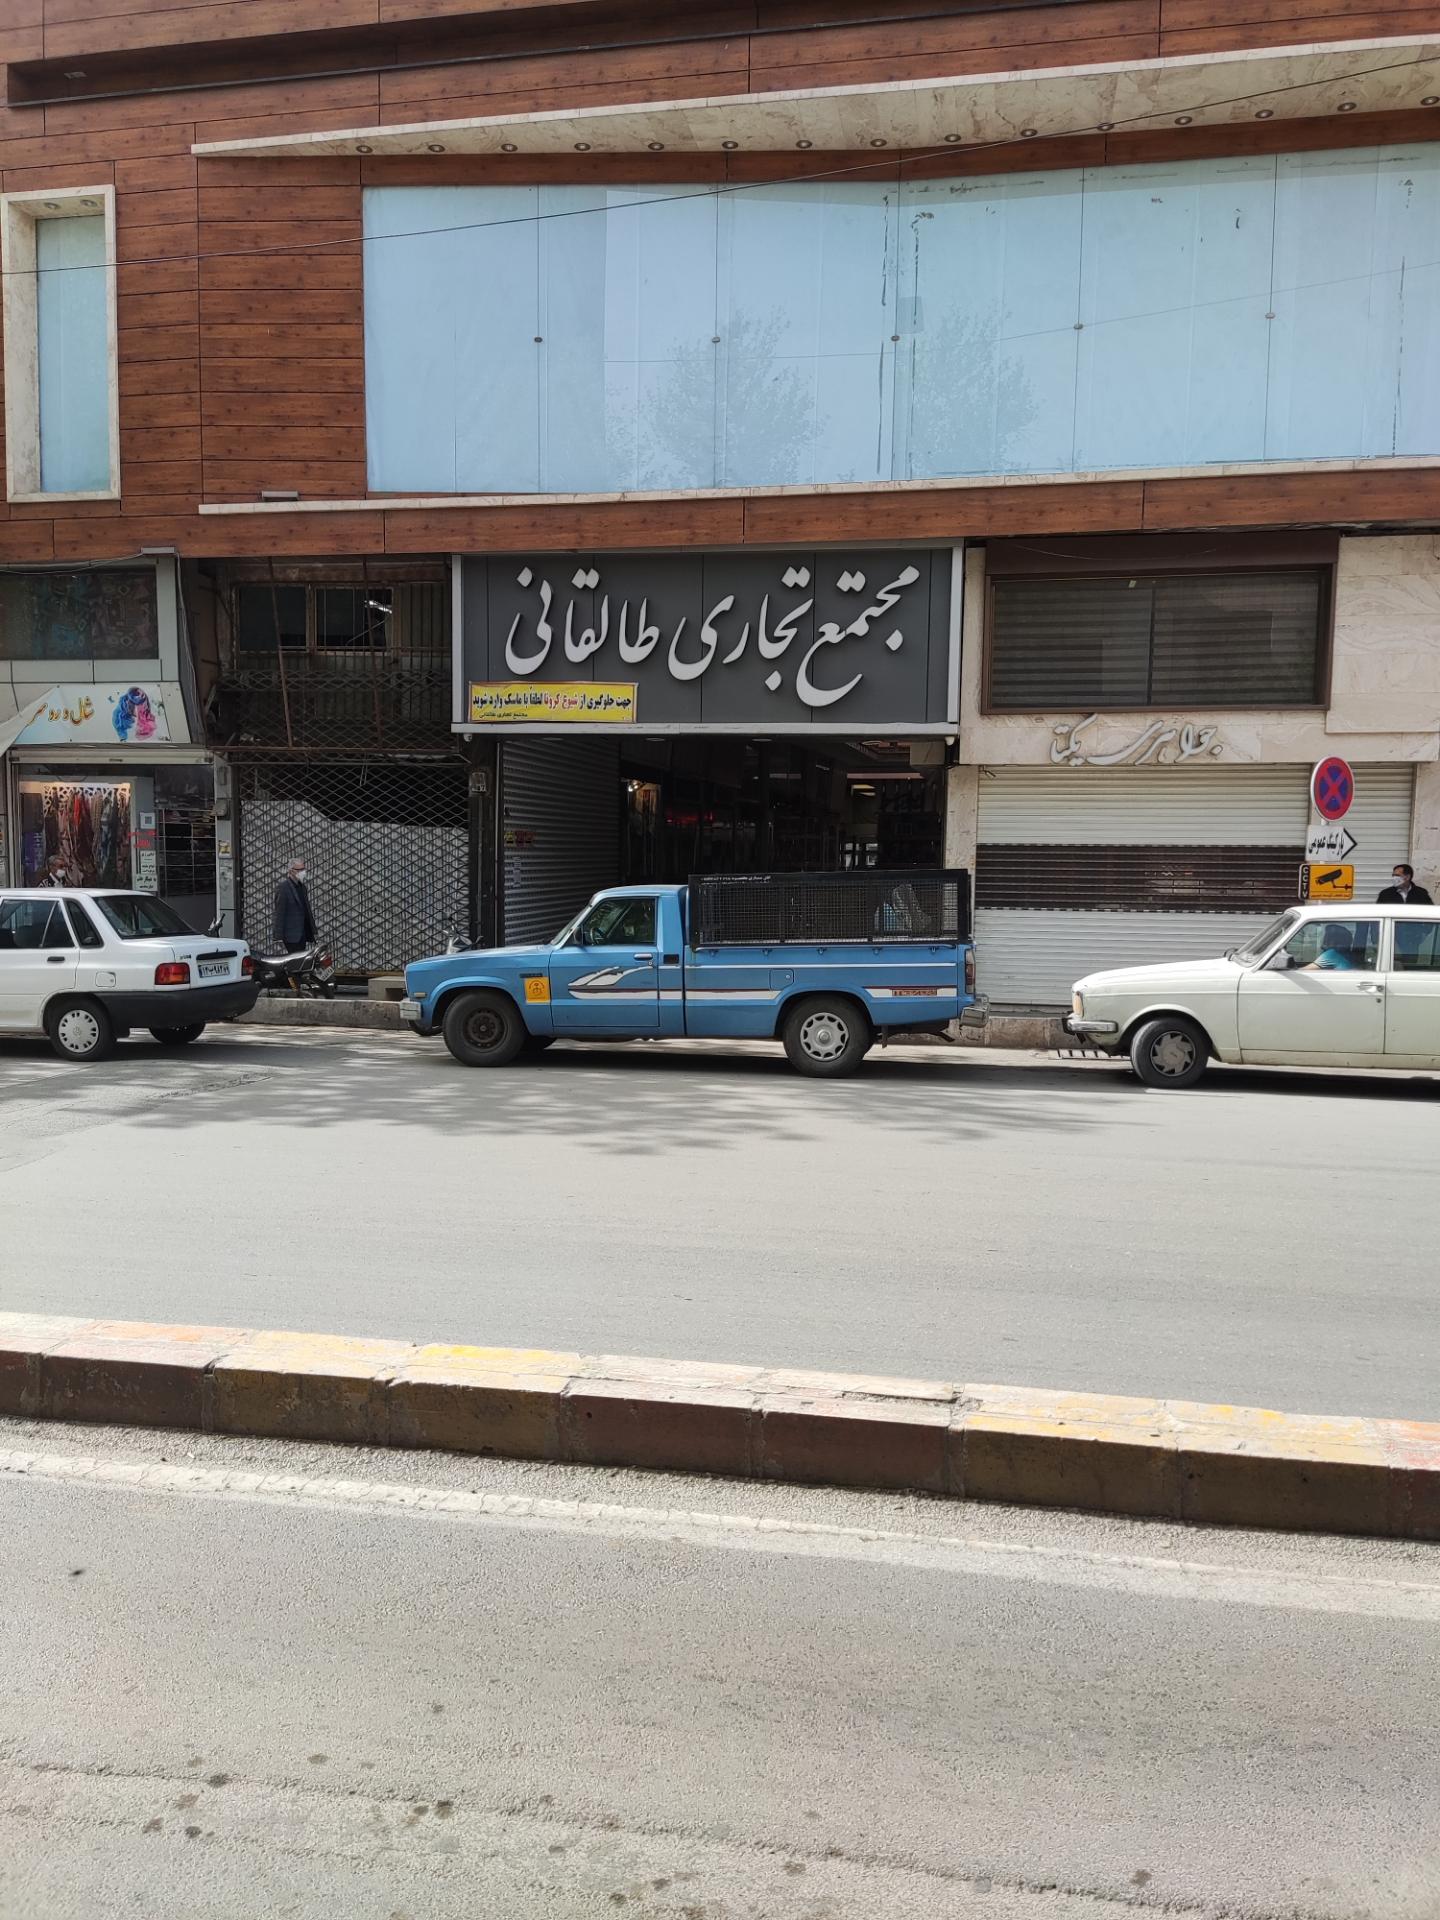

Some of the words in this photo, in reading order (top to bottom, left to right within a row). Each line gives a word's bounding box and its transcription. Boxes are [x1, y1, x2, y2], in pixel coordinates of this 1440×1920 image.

[504, 566, 661, 676] طالقانی
[668, 566, 814, 691] تجاری
[796, 565, 920, 707] مجتمع
[504, 692, 521, 705] ماسک
[544, 692, 561, 709] کرونا
[616, 696, 632, 710] جهت
[1050, 712, 1098, 767] یکتا
[1086, 720, 1224, 766] جواهری
